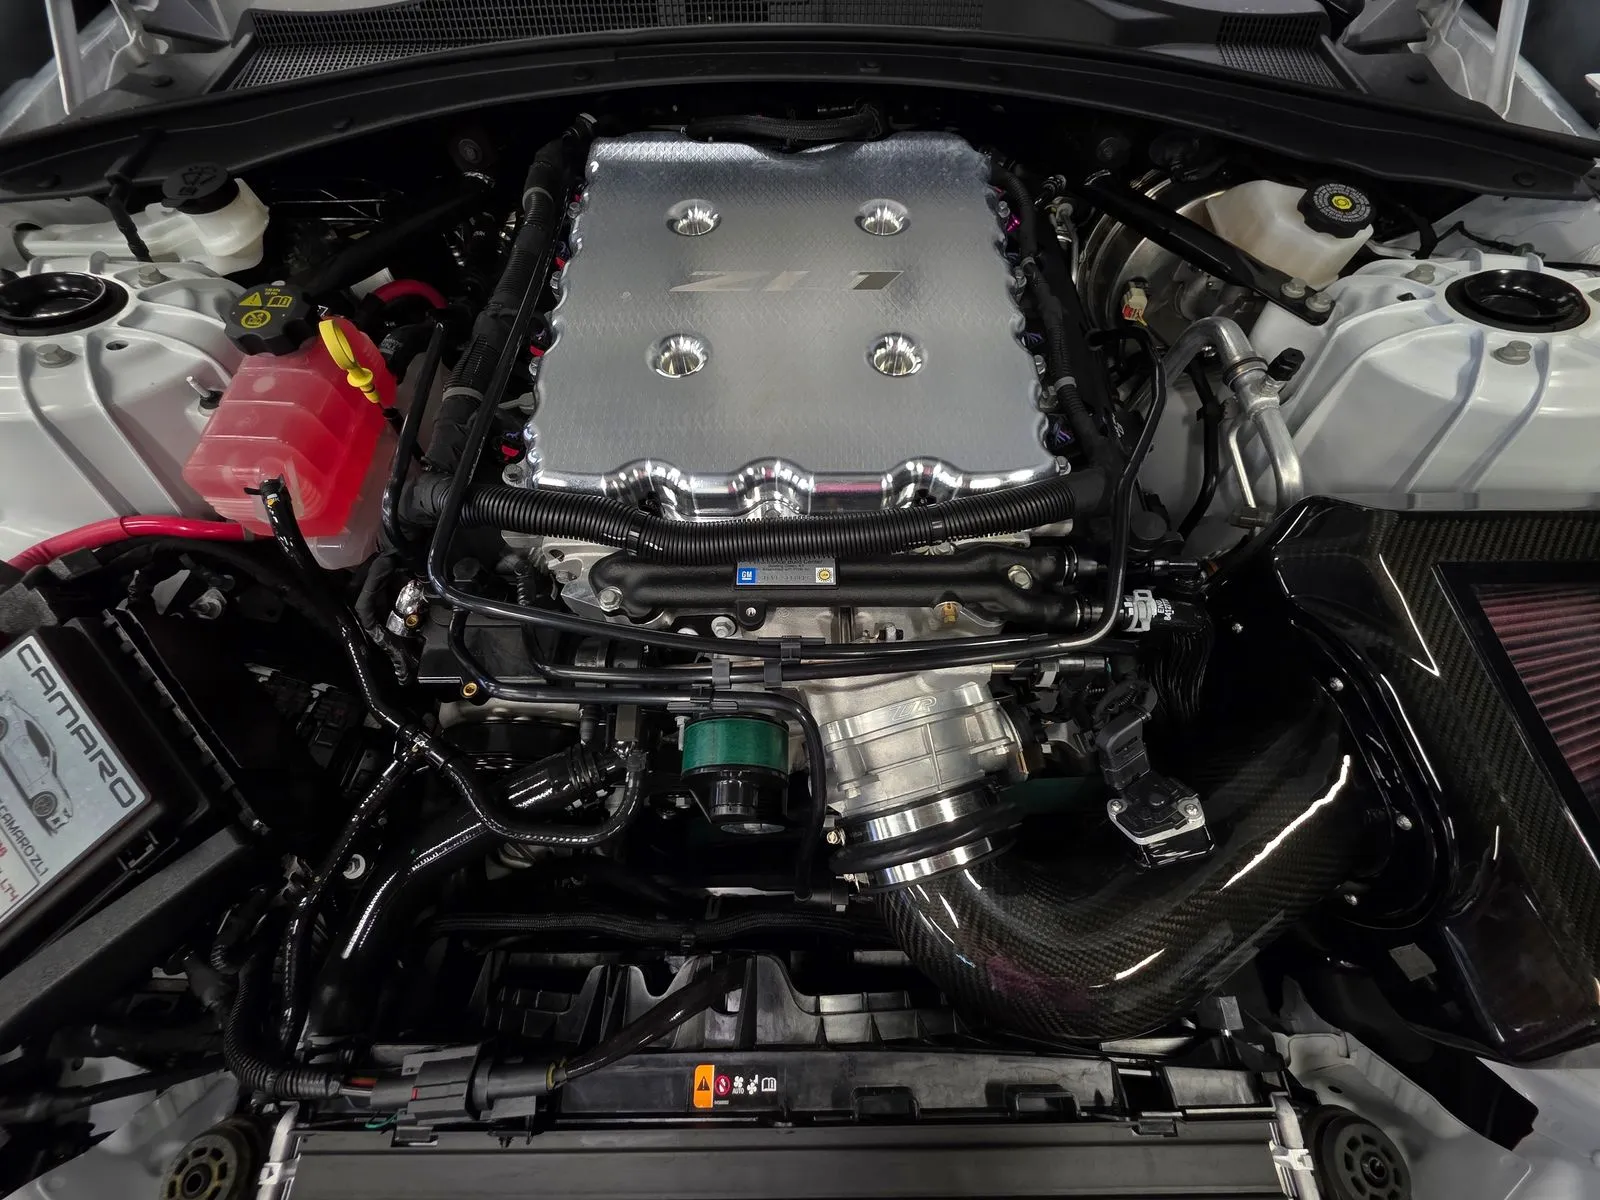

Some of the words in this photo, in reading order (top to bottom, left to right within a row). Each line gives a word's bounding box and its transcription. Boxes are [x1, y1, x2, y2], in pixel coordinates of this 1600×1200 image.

[741, 571, 753, 579] GM
[17, 643, 136, 808] CAMARO
[30, 854, 49, 877] ZL1
[0, 877, 20, 902] LT4
[732, 1087, 745, 1095] AUTO
